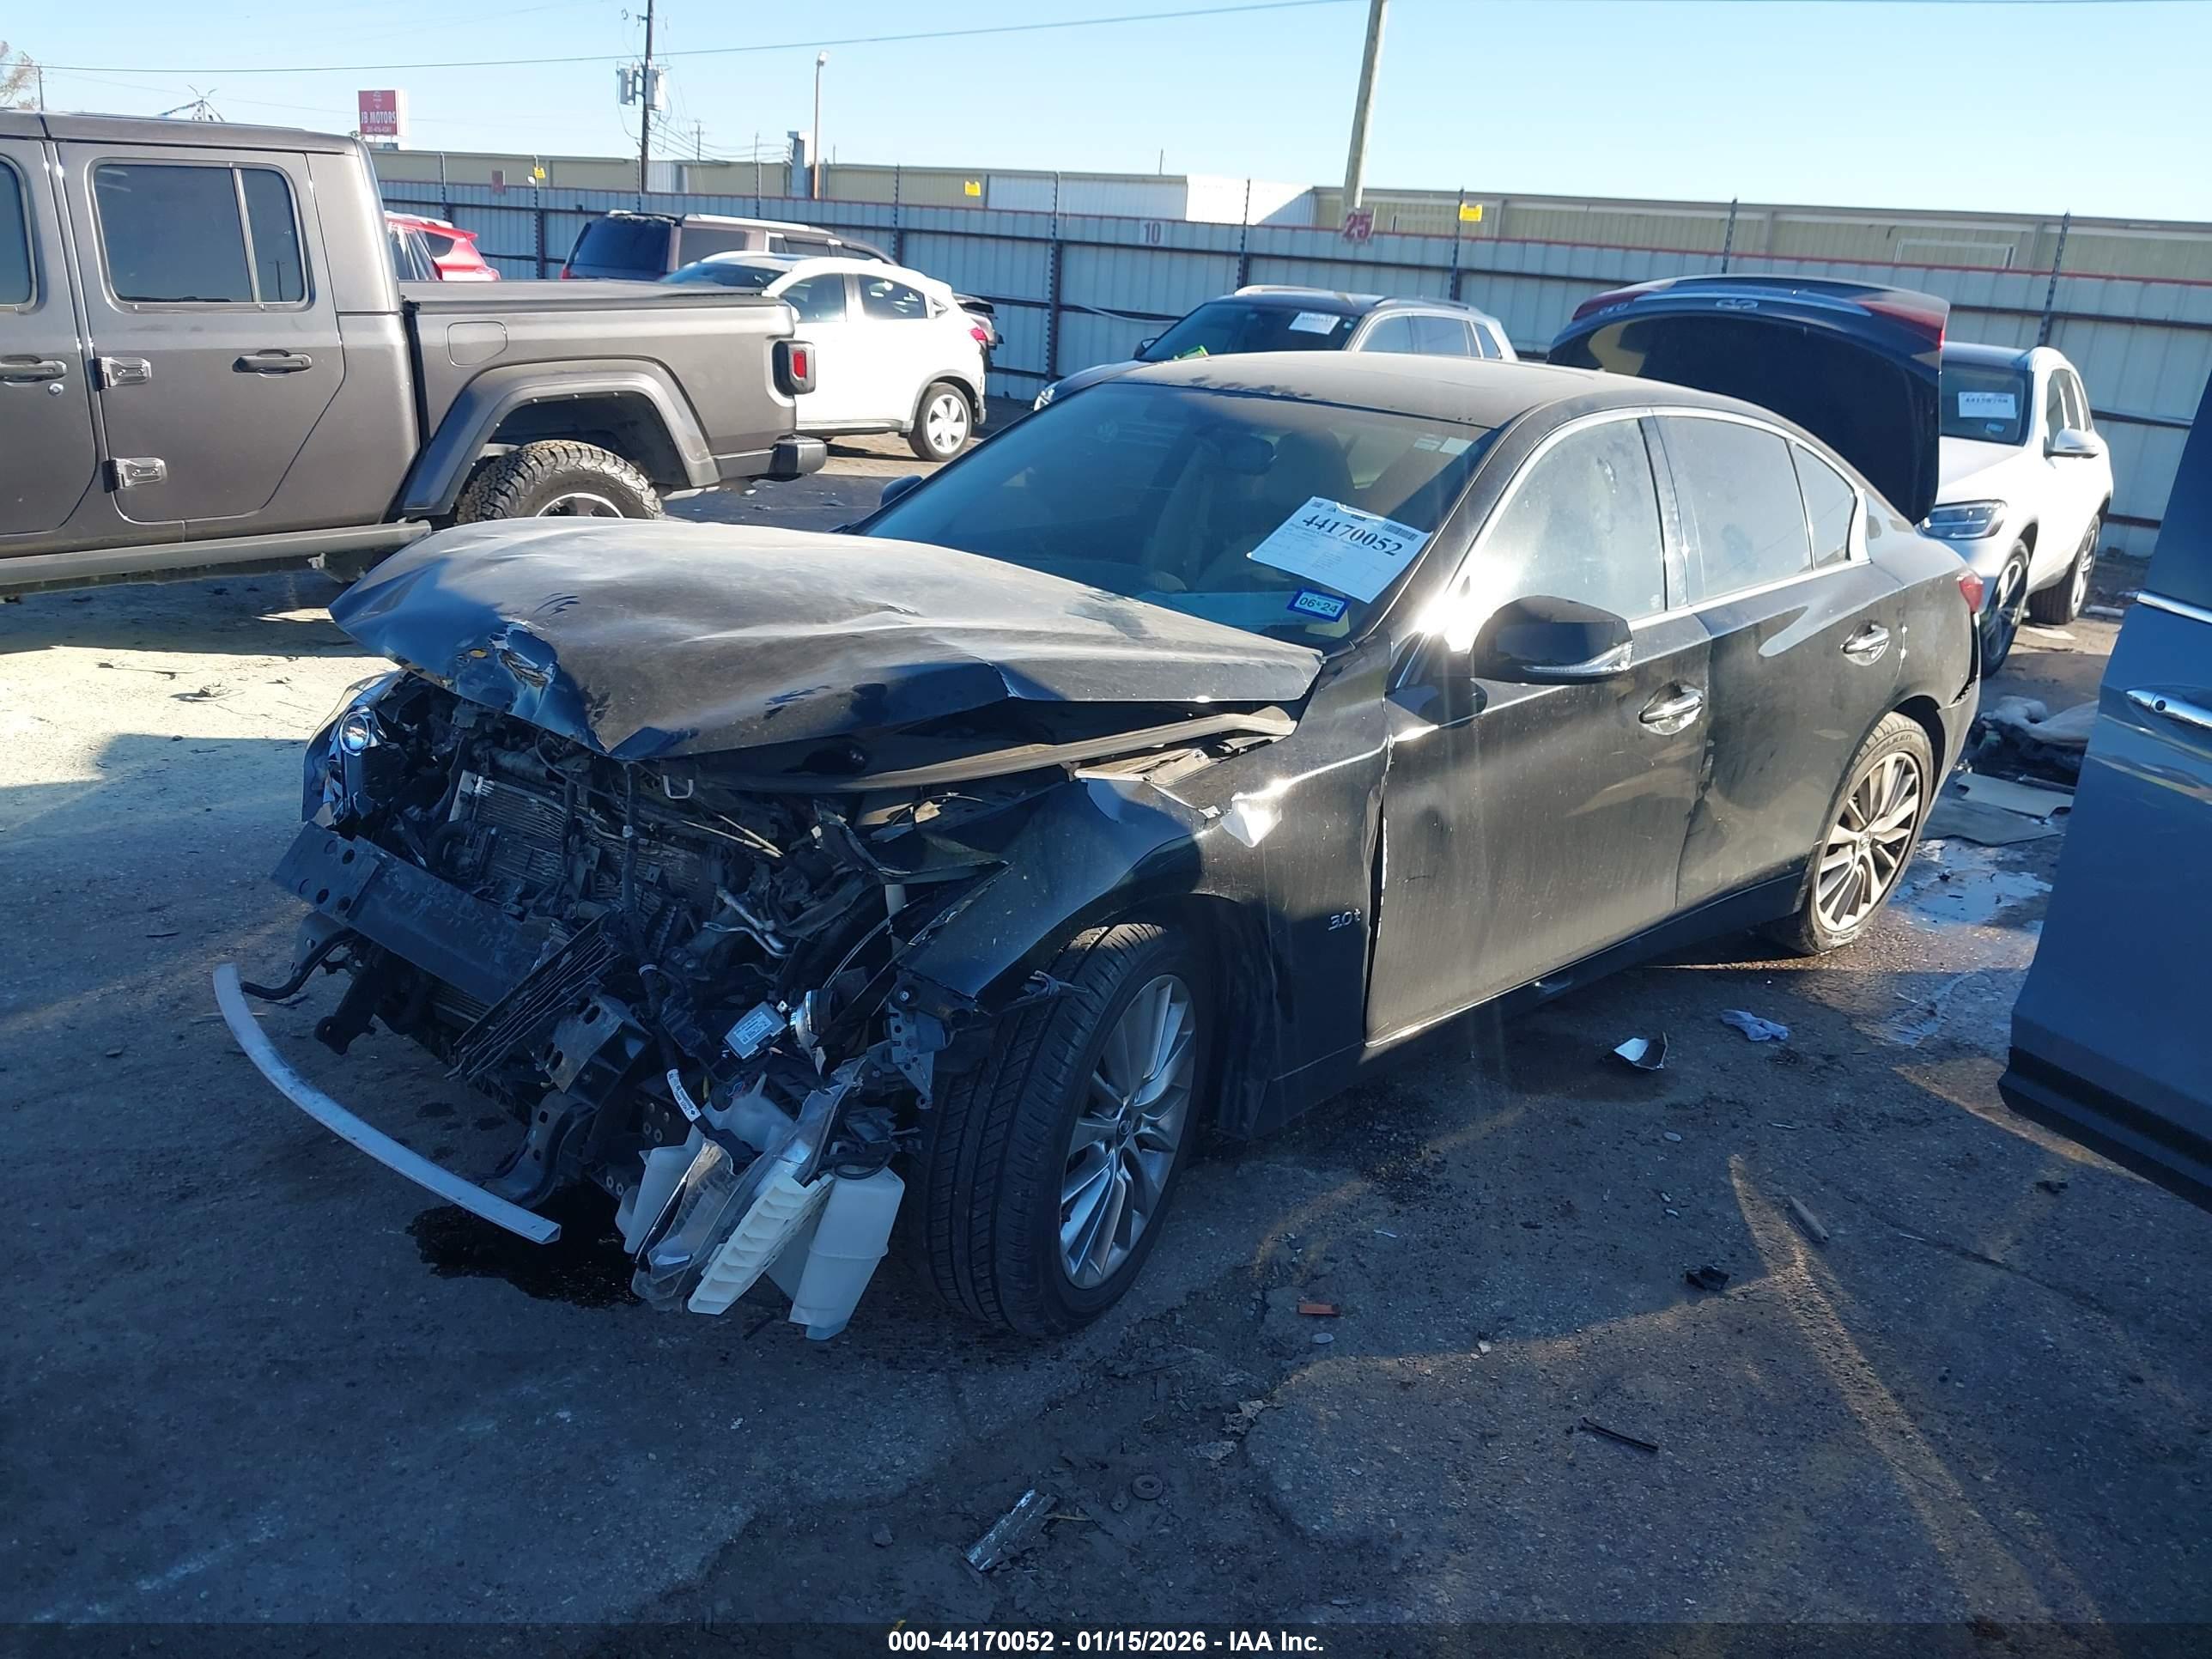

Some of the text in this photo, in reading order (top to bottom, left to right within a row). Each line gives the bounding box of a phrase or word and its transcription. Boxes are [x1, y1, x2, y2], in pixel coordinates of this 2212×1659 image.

[370, 112, 396, 124] MOTORS
[1144, 222, 1162, 245] 10
[1343, 214, 1371, 240] 25
[1303, 514, 1403, 556] 44170052
[1328, 908, 1361, 931] 3.0t
